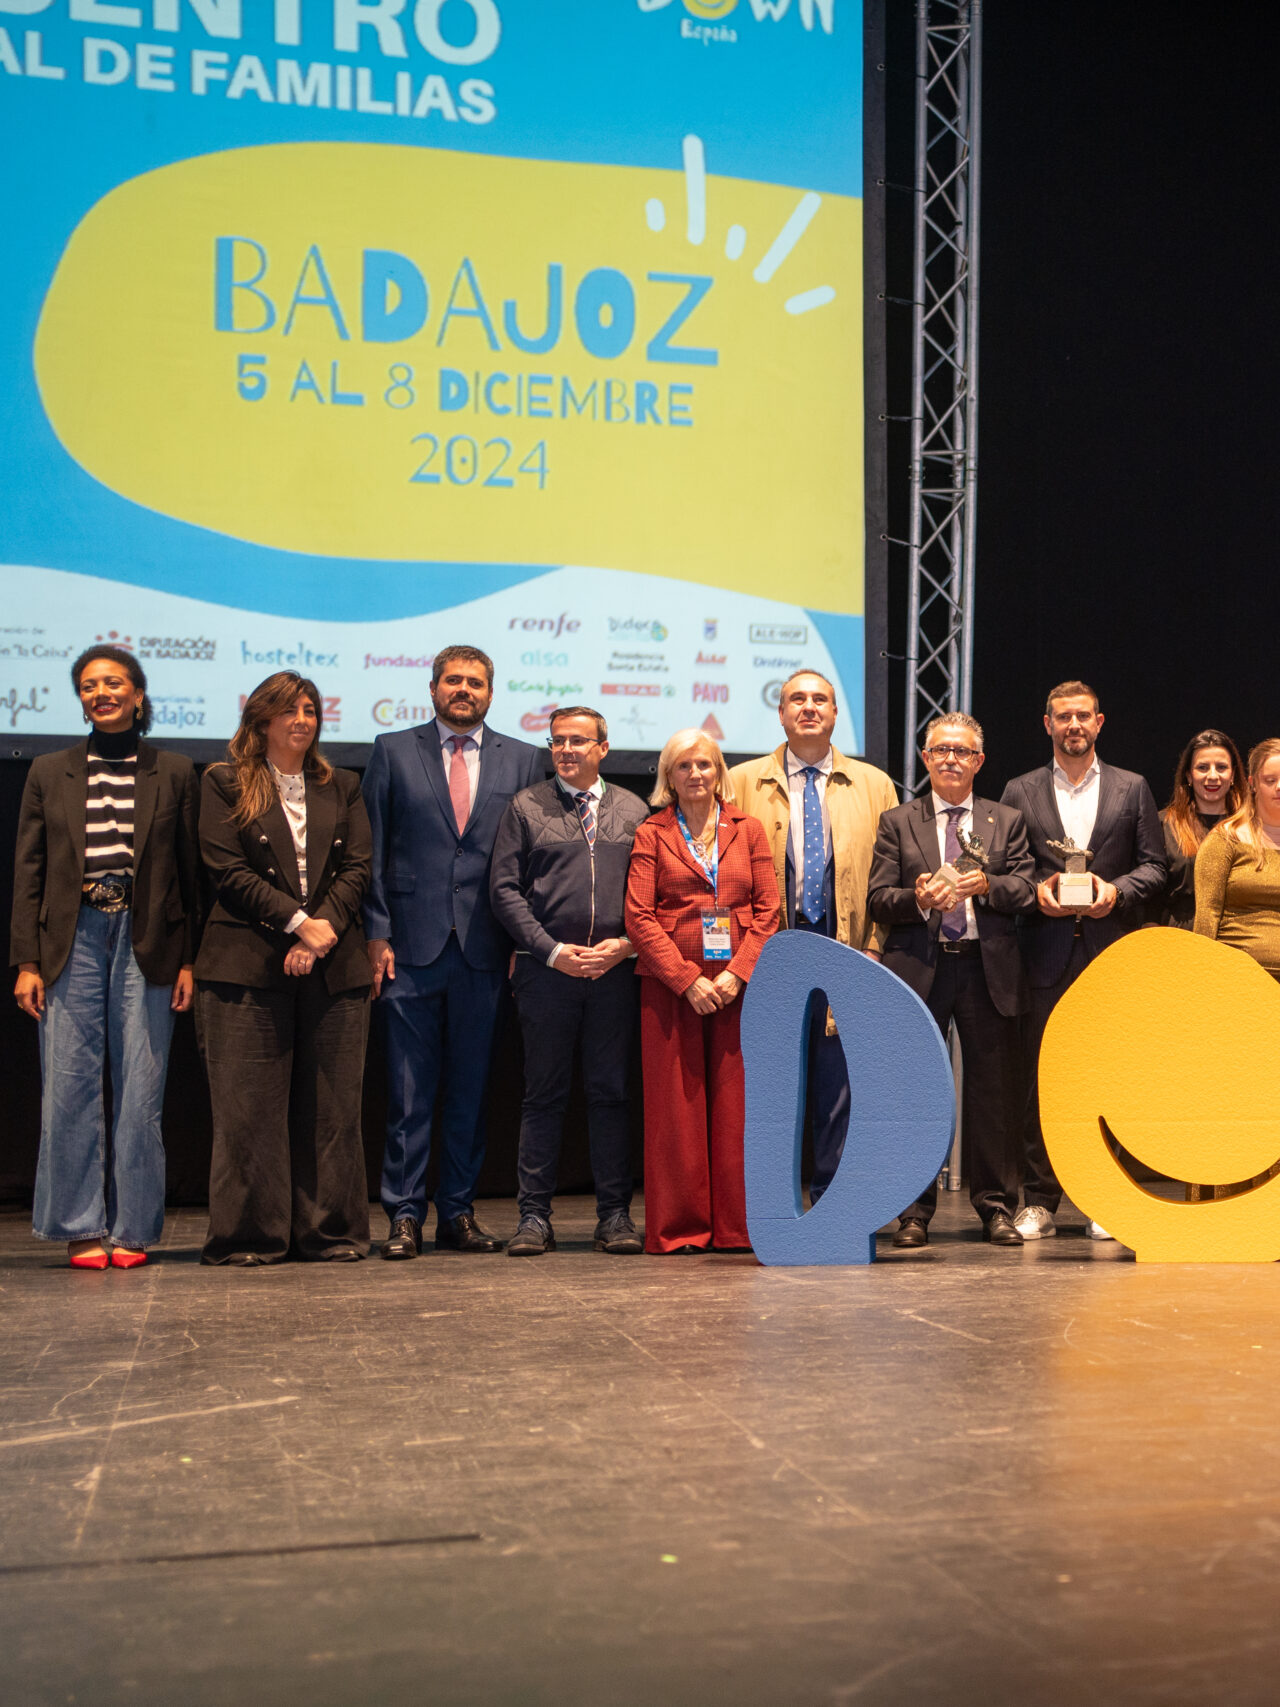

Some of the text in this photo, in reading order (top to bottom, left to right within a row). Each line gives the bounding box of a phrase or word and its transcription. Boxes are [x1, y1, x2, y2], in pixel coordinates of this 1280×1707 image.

[680, 18, 738, 46] España
[83, 37, 176, 92] DE
[191, 49, 497, 125] FAMILIAS
[213, 236, 720, 367] BADAJOZ
[236, 354, 695, 427] 5 AL 8 DICIEMBRE
[408, 432, 550, 490] 2024
[507, 611, 582, 639] renfe
[139, 635, 216, 649] DIPUTACIÓN
[155, 649, 216, 660] BADAJOZ
[241, 640, 339, 667] hosteltex
[521, 649, 569, 667] alsa
